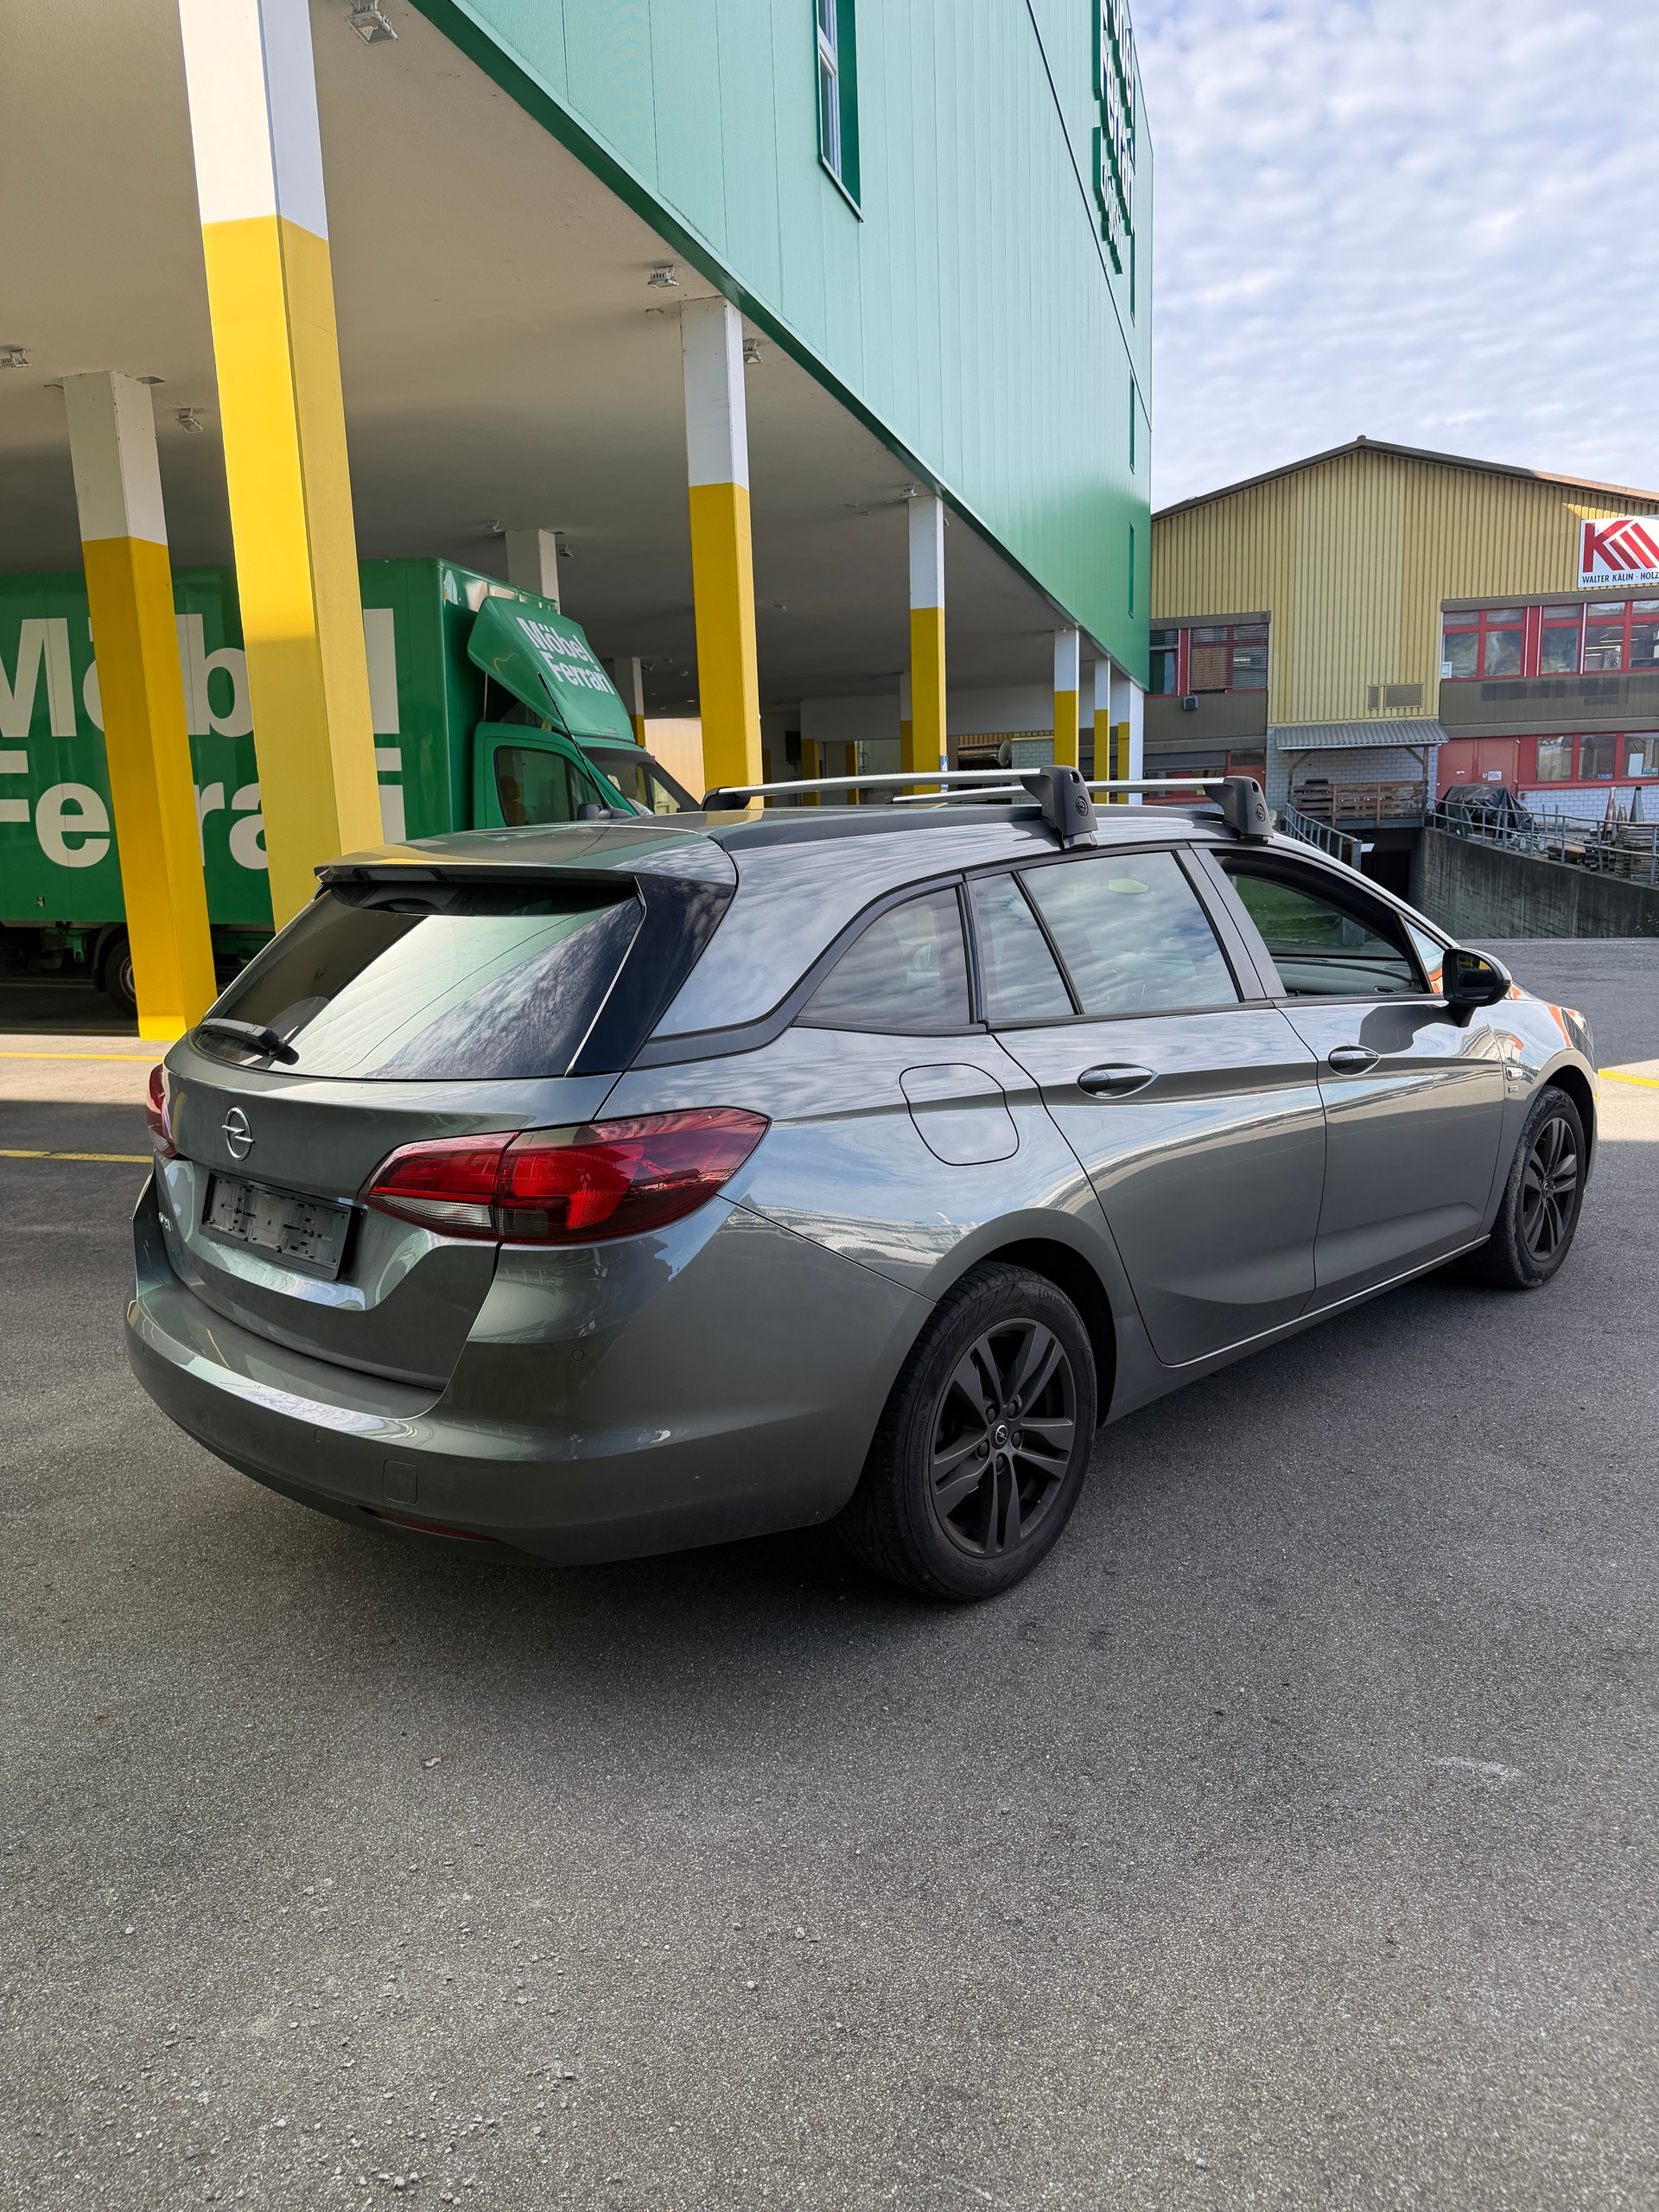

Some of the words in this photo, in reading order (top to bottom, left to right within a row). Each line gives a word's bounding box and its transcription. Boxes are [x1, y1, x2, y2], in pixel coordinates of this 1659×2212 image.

[1582, 575, 1609, 584] WALTER
[1611, 572, 1634, 582] KÄLIN
[516, 616, 595, 664] Möbel
[539, 650, 615, 695] Ferrari
